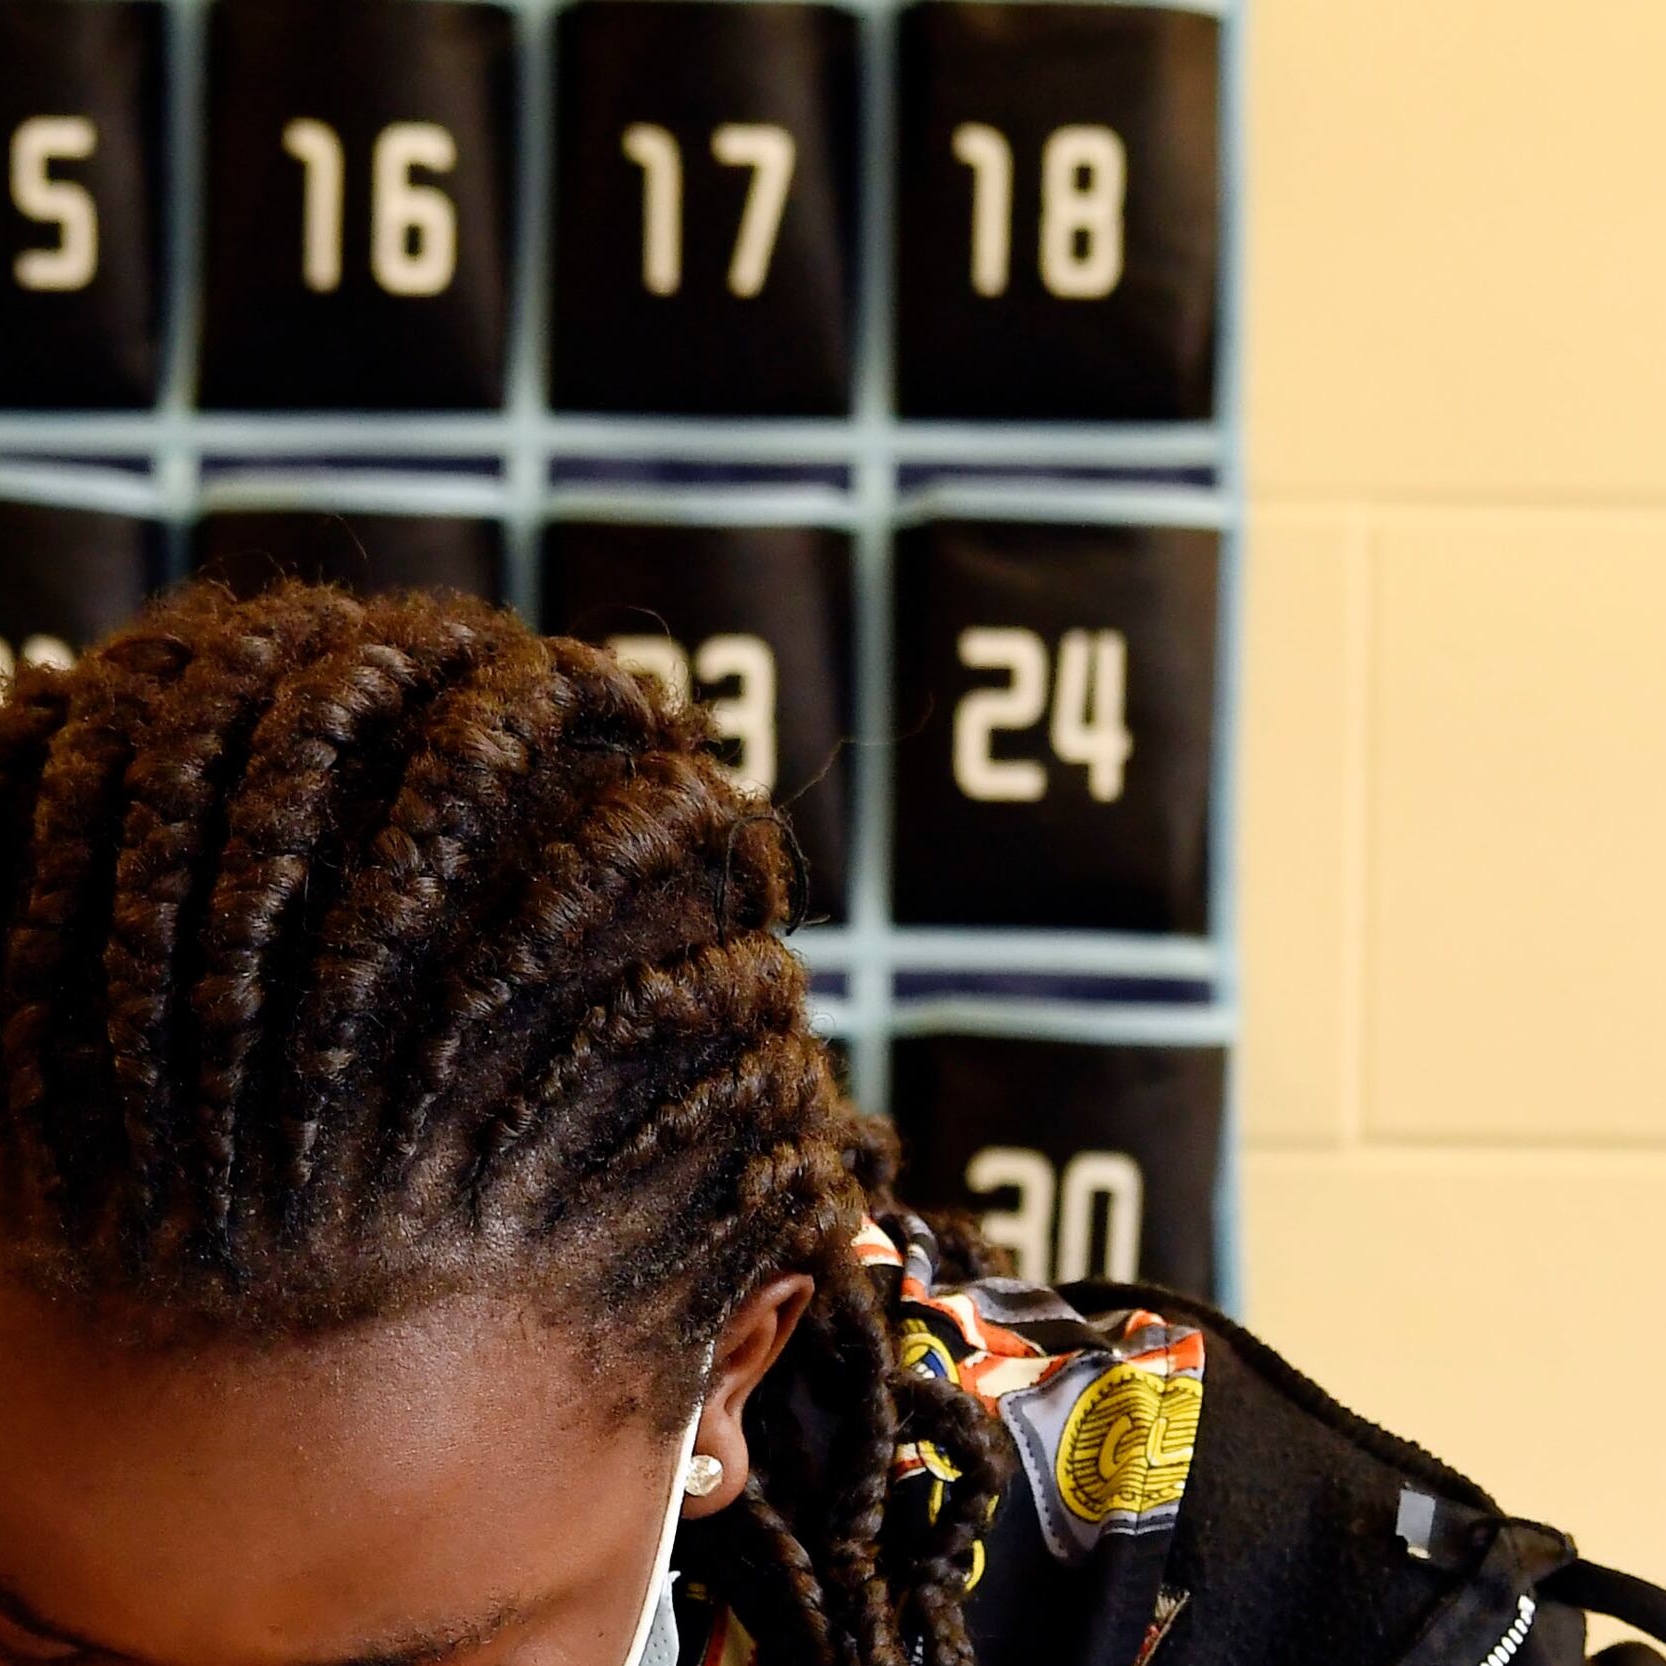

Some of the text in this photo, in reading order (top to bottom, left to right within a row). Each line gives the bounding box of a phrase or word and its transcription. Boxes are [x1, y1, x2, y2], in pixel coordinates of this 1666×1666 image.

[283, 119, 457, 296] 16
[623, 122, 797, 298] 17
[953, 123, 1127, 299] 18
[952, 627, 1133, 803] 24
[964, 1145, 1144, 1287] 30
